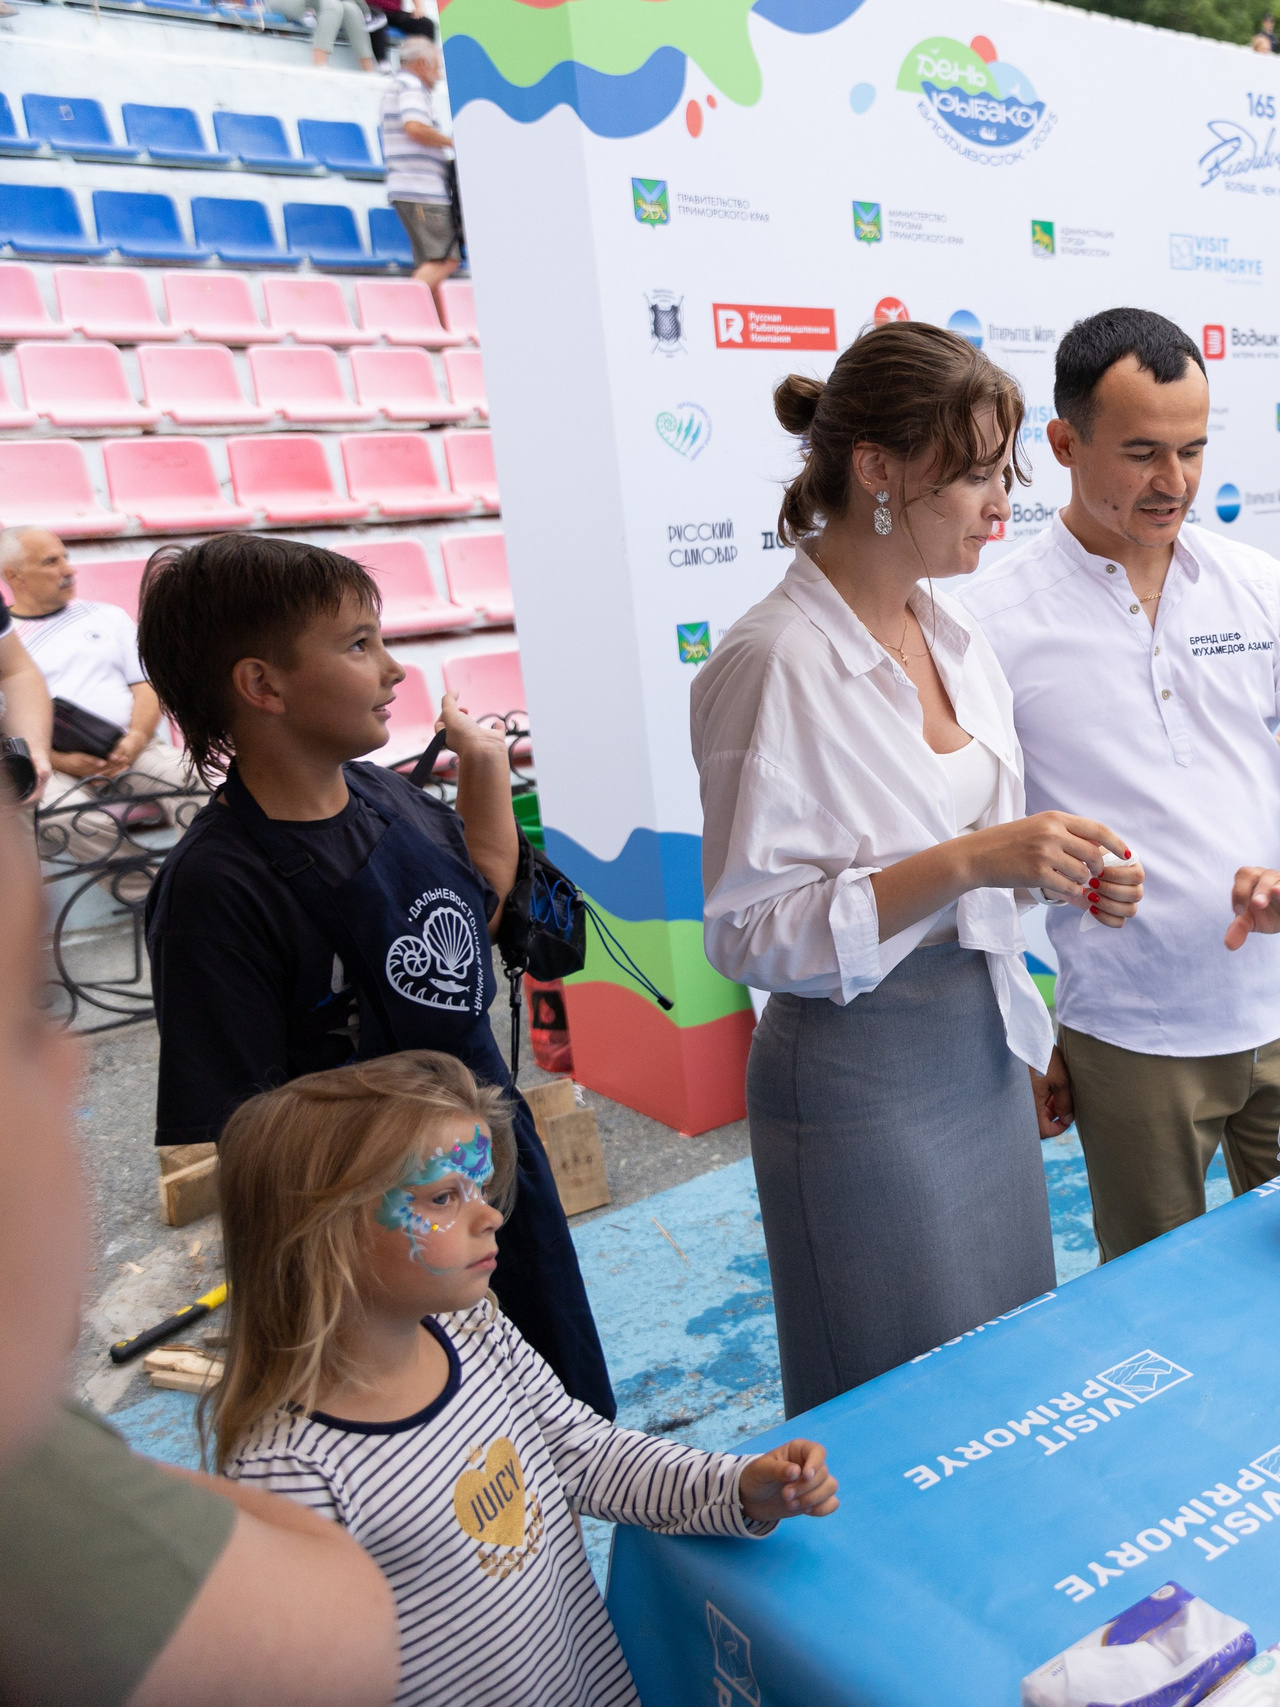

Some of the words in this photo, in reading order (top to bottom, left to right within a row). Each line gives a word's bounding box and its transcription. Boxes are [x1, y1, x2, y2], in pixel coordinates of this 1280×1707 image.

[1247, 92, 1276, 120] 165
[677, 193, 750, 209] ПРАВИТЕЛЬСТВО
[678, 205, 749, 221] ПРИМОРСКОГО
[750, 212, 770, 222] КРАЯ
[1194, 236, 1229, 253] VISIT
[1194, 255, 1263, 276] PRIMORYE
[748, 310, 782, 323] Русская
[750, 333, 791, 344] Компания
[1231, 328, 1279, 347] Водник
[1024, 405, 1054, 422] VISI
[668, 518, 735, 542] РУССКИЙ
[669, 545, 738, 567] САМОВАР
[1190, 634, 1219, 645] БРЕНД
[1220, 632, 1241, 642] ШЕФ
[1192, 643, 1246, 656] МУХАМЕДОВ
[1248, 641, 1274, 651] АЗАМАТ
[903, 1379, 1110, 1490] PRIMORYE
[1035, 1397, 1136, 1456] VISIT
[471, 1459, 520, 1533] JUICY
[1053, 1468, 1266, 1602] PRIMORYE
